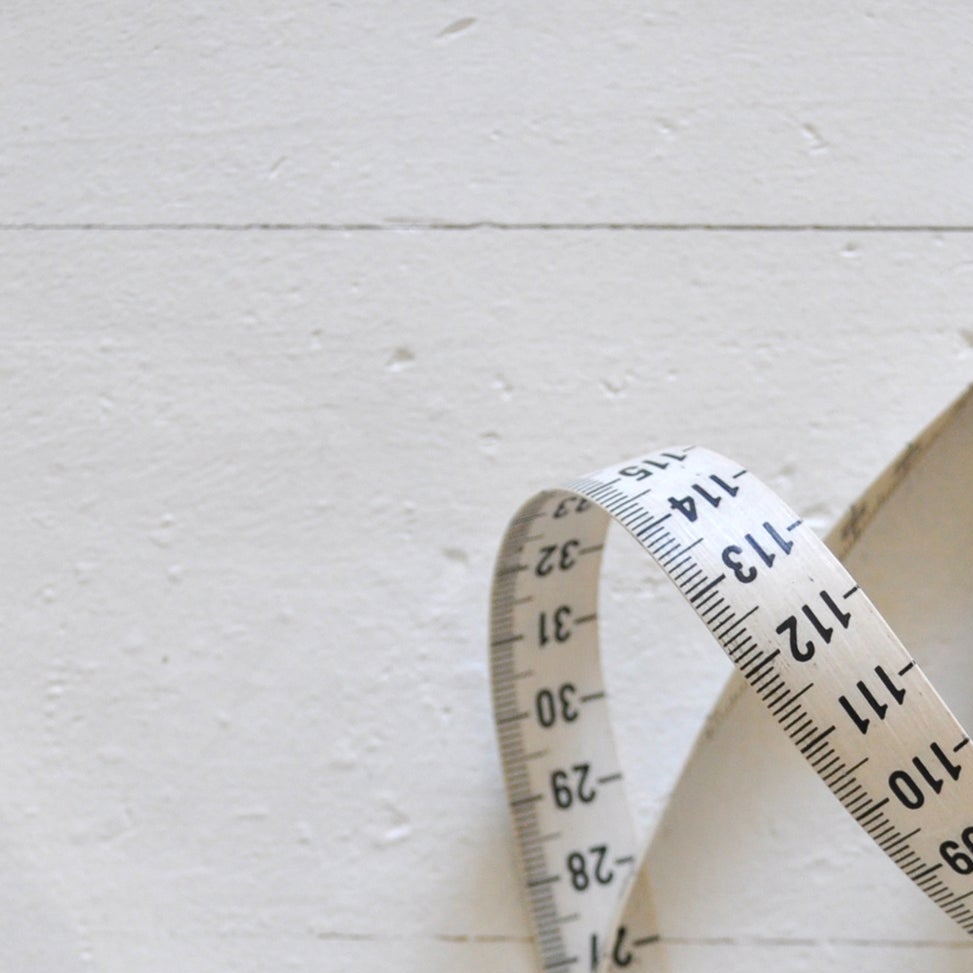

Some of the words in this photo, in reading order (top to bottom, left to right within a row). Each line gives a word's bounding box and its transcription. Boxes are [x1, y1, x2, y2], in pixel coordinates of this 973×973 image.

[668, 474, 740, 522] 114
[535, 539, 580, 577] 32
[721, 521, 794, 584] 113
[538, 605, 572, 645] 31
[776, 590, 851, 662] 112
[536, 683, 578, 727] 30
[838, 665, 906, 735] 111
[551, 763, 597, 809] 29
[888, 742, 962, 810] 110
[566, 846, 613, 890] 28
